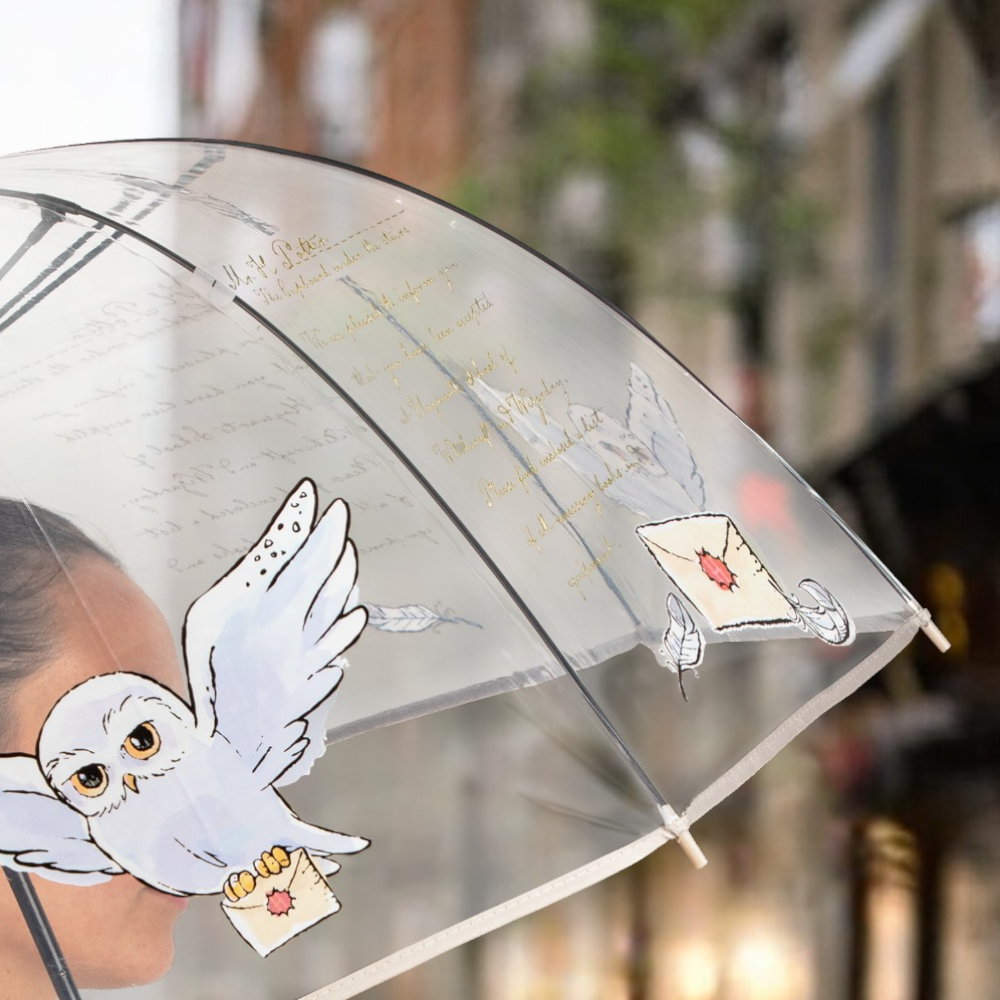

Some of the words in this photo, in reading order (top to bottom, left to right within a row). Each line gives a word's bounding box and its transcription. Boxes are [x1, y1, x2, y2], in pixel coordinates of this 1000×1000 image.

[222, 263, 256, 290] Mr
[271, 233, 328, 270] Potter
[252, 287, 283, 305] The
[277, 263, 332, 299] Cupboard
[333, 250, 364, 271] under
[455, 291, 495, 327] accepted
[539, 428, 576, 467] enclosed
[580, 407, 605, 433] list
